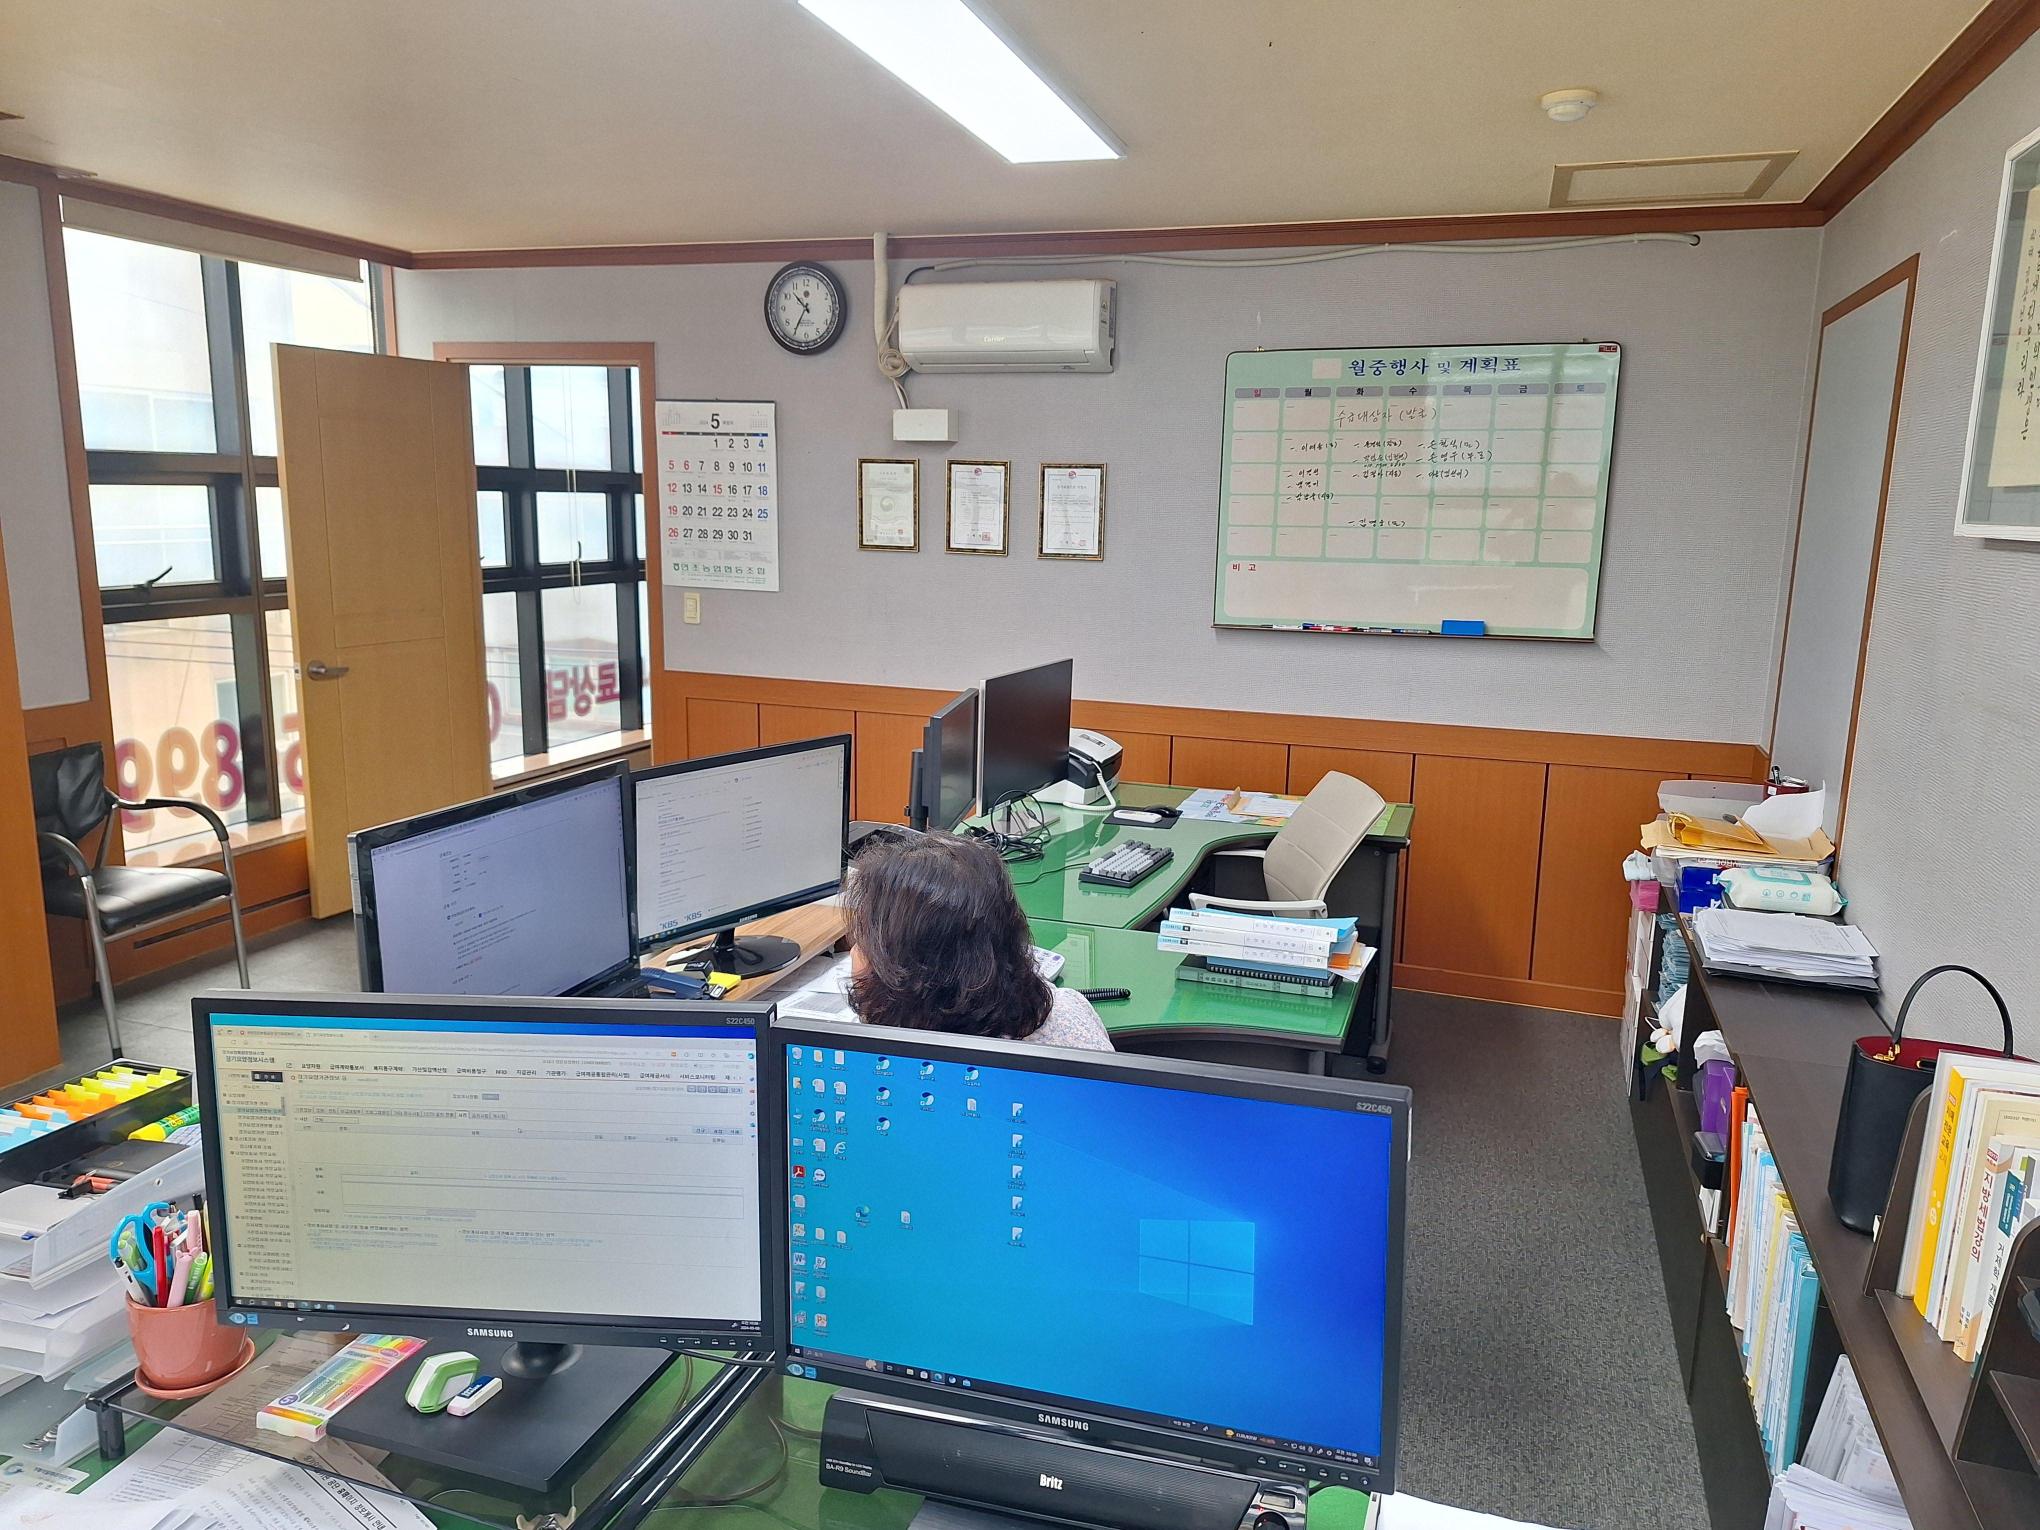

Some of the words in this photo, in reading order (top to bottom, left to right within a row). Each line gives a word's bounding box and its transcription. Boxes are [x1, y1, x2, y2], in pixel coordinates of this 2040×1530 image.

[793, 282, 797, 290] 11
[817, 282, 819, 290] 1
[1347, 359, 1429, 377] 월중행사
[1438, 361, 1451, 373] 및
[1459, 356, 1521, 373] 계획표
[1304, 388, 1313, 396] 월
[1356, 388, 1365, 396] 화
[1408, 387, 1418, 395] 수
[1463, 387, 1472, 395] 목
[1518, 386, 1527, 394] 금
[711, 413, 720, 429] 5
[1335, 408, 1392, 428] 수급대상자
[729, 439, 734, 448] 2
[744, 439, 749, 448] 3
[759, 440, 763, 448] 4
[669, 461, 674, 470] 5
[684, 461, 689, 470] 6
[699, 461, 704, 471] 7
[714, 462, 719, 471] 8
[729, 462, 734, 471] 9
[742, 463, 752, 472] 10
[758, 463, 766, 472] 11
[668, 484, 677, 492] 12
[683, 484, 692, 493] 13
[698, 484, 707, 493] 14
[713, 485, 722, 494] 15
[728, 485, 737, 495] 16
[743, 485, 751, 495] 17
[758, 486, 767, 495] 18
[668, 506, 677, 515] 19
[683, 506, 693, 516] 20
[698, 507, 707, 516] 21
[713, 507, 722, 517] 22
[728, 508, 738, 517] 23
[743, 509, 752, 518] 24
[758, 509, 768, 519] 25
[669, 528, 678, 538] 26
[683, 529, 693, 538] 27
[698, 530, 708, 539] 28
[713, 530, 723, 540] 29
[728, 531, 738, 540] 30
[743, 531, 752, 541] 31
[686, 911, 702, 921] KBS
[662, 920, 678, 929] KBS
[726, 1017, 755, 1025] S22C450
[1356, 1102, 1392, 1114] S22C450
[1971, 1171, 1994, 1263] 지방세법강의
[467, 1328, 513, 1338] SAMSUNG
[1038, 1413, 1089, 1431] SAMSUNG
[1040, 1473, 1063, 1490] Britz
